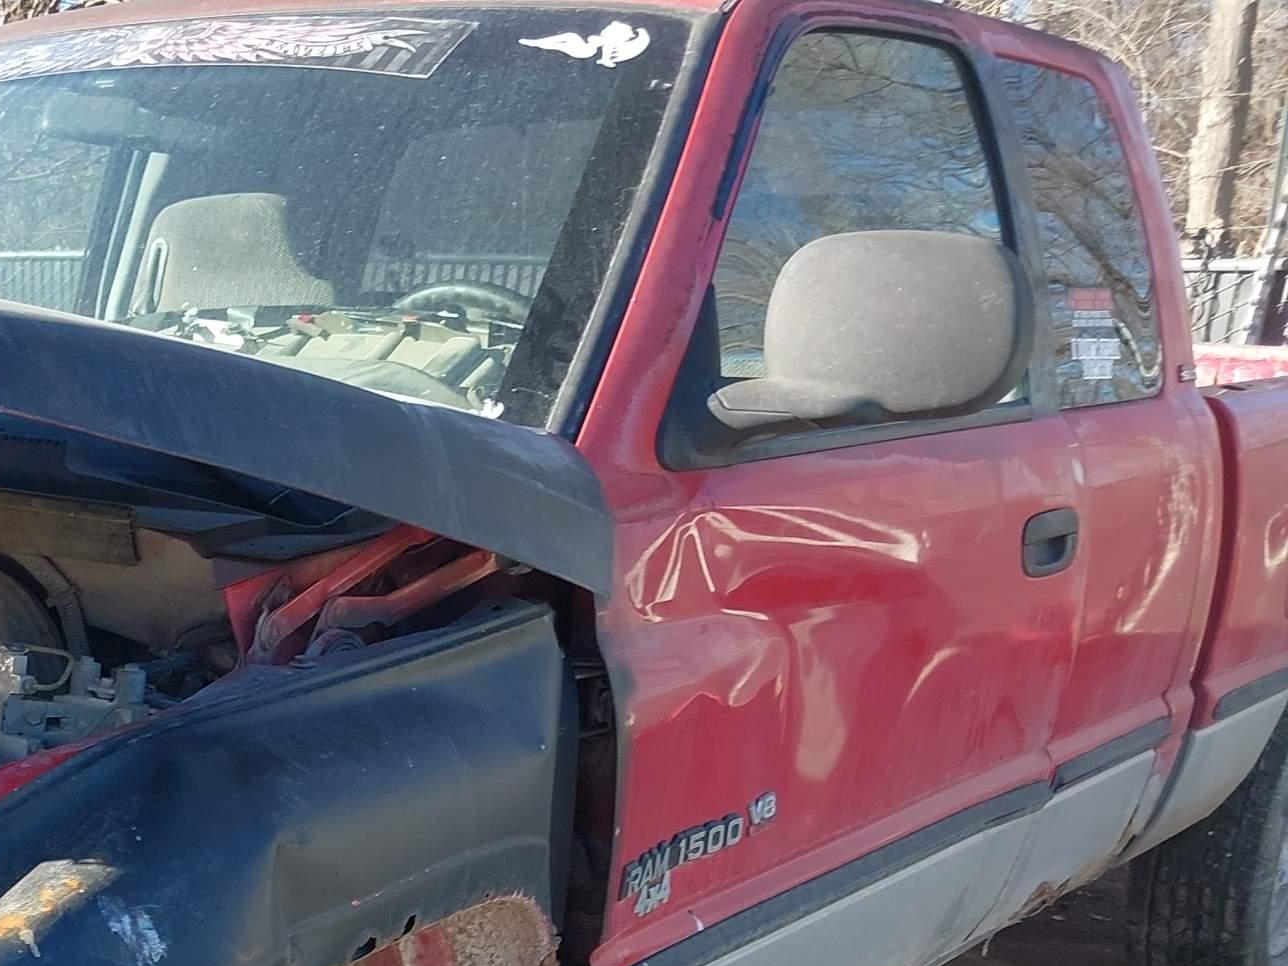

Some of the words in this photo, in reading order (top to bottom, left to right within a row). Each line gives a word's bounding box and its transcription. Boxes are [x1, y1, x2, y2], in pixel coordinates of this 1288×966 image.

[621, 844, 672, 898] RAM
[674, 814, 744, 866] 1500
[746, 790, 777, 826] V8
